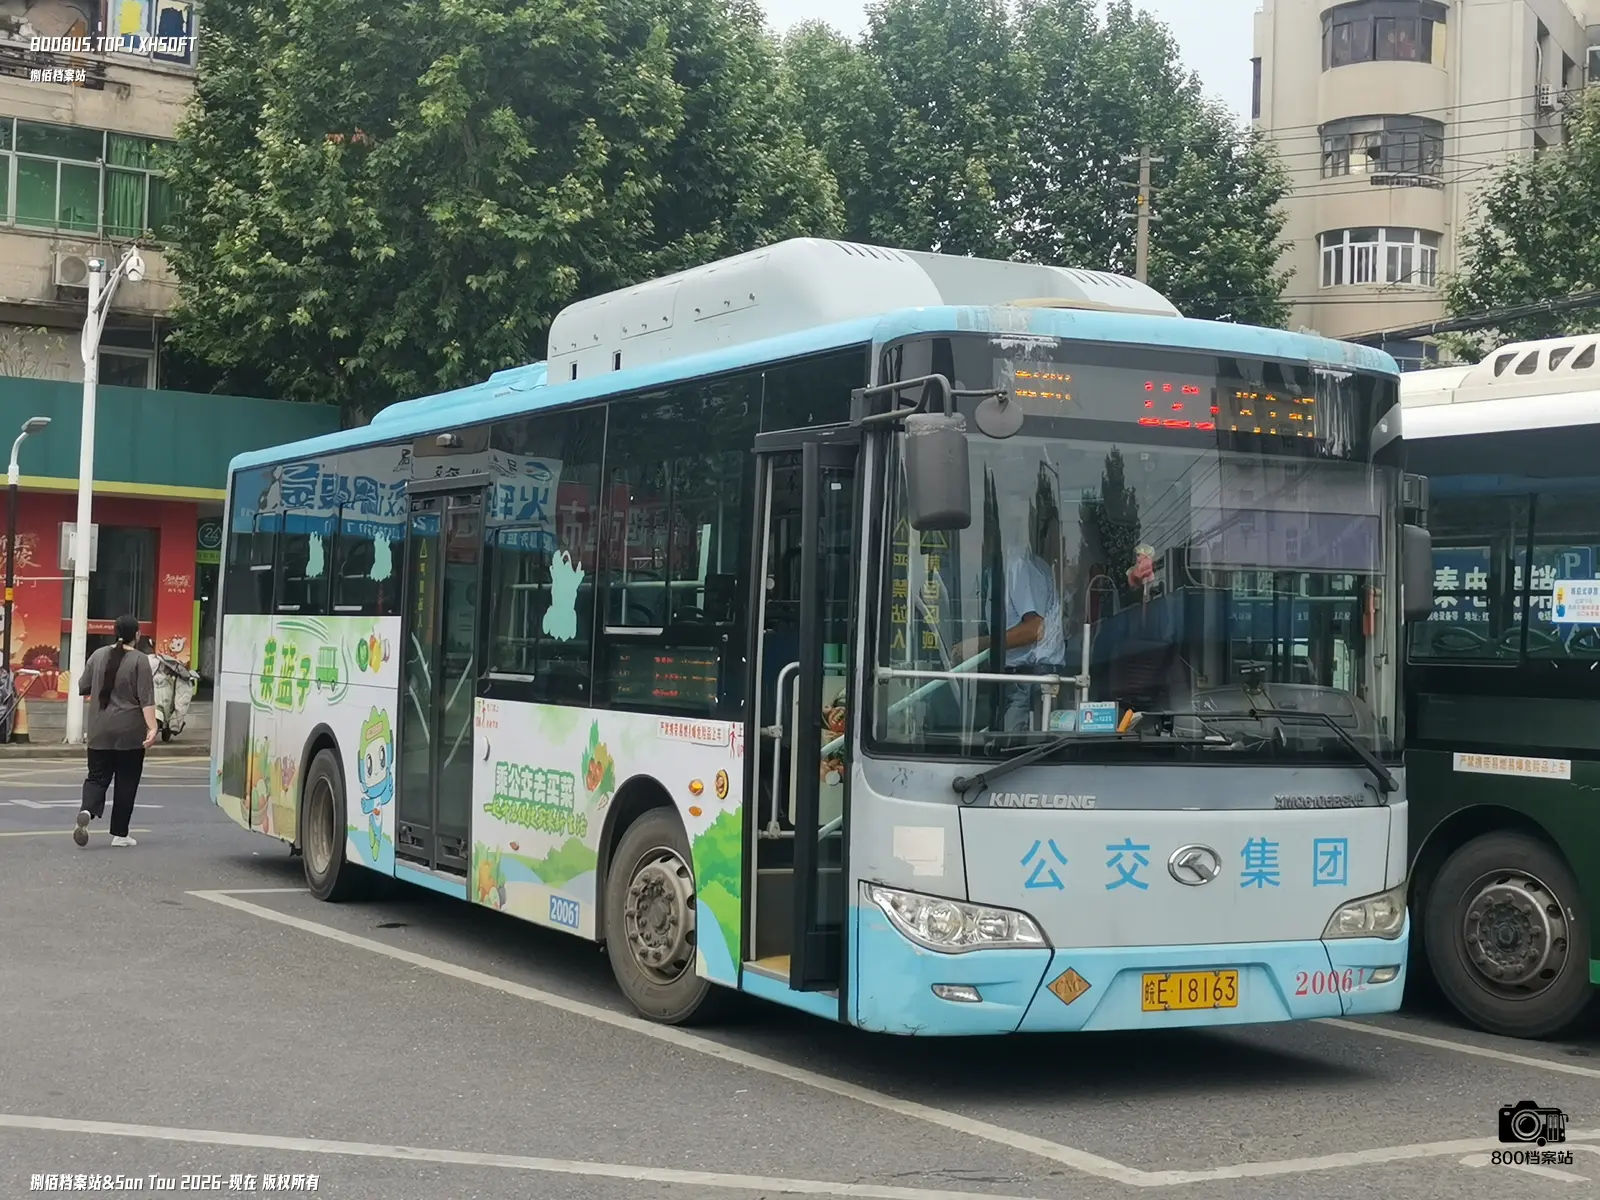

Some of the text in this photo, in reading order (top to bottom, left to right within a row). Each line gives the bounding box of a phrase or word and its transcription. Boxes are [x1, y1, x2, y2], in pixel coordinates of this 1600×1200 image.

[1020, 837, 1349, 891] 公交集团
[551, 897, 579, 927] 20061
[1295, 968, 1365, 995] 20061
